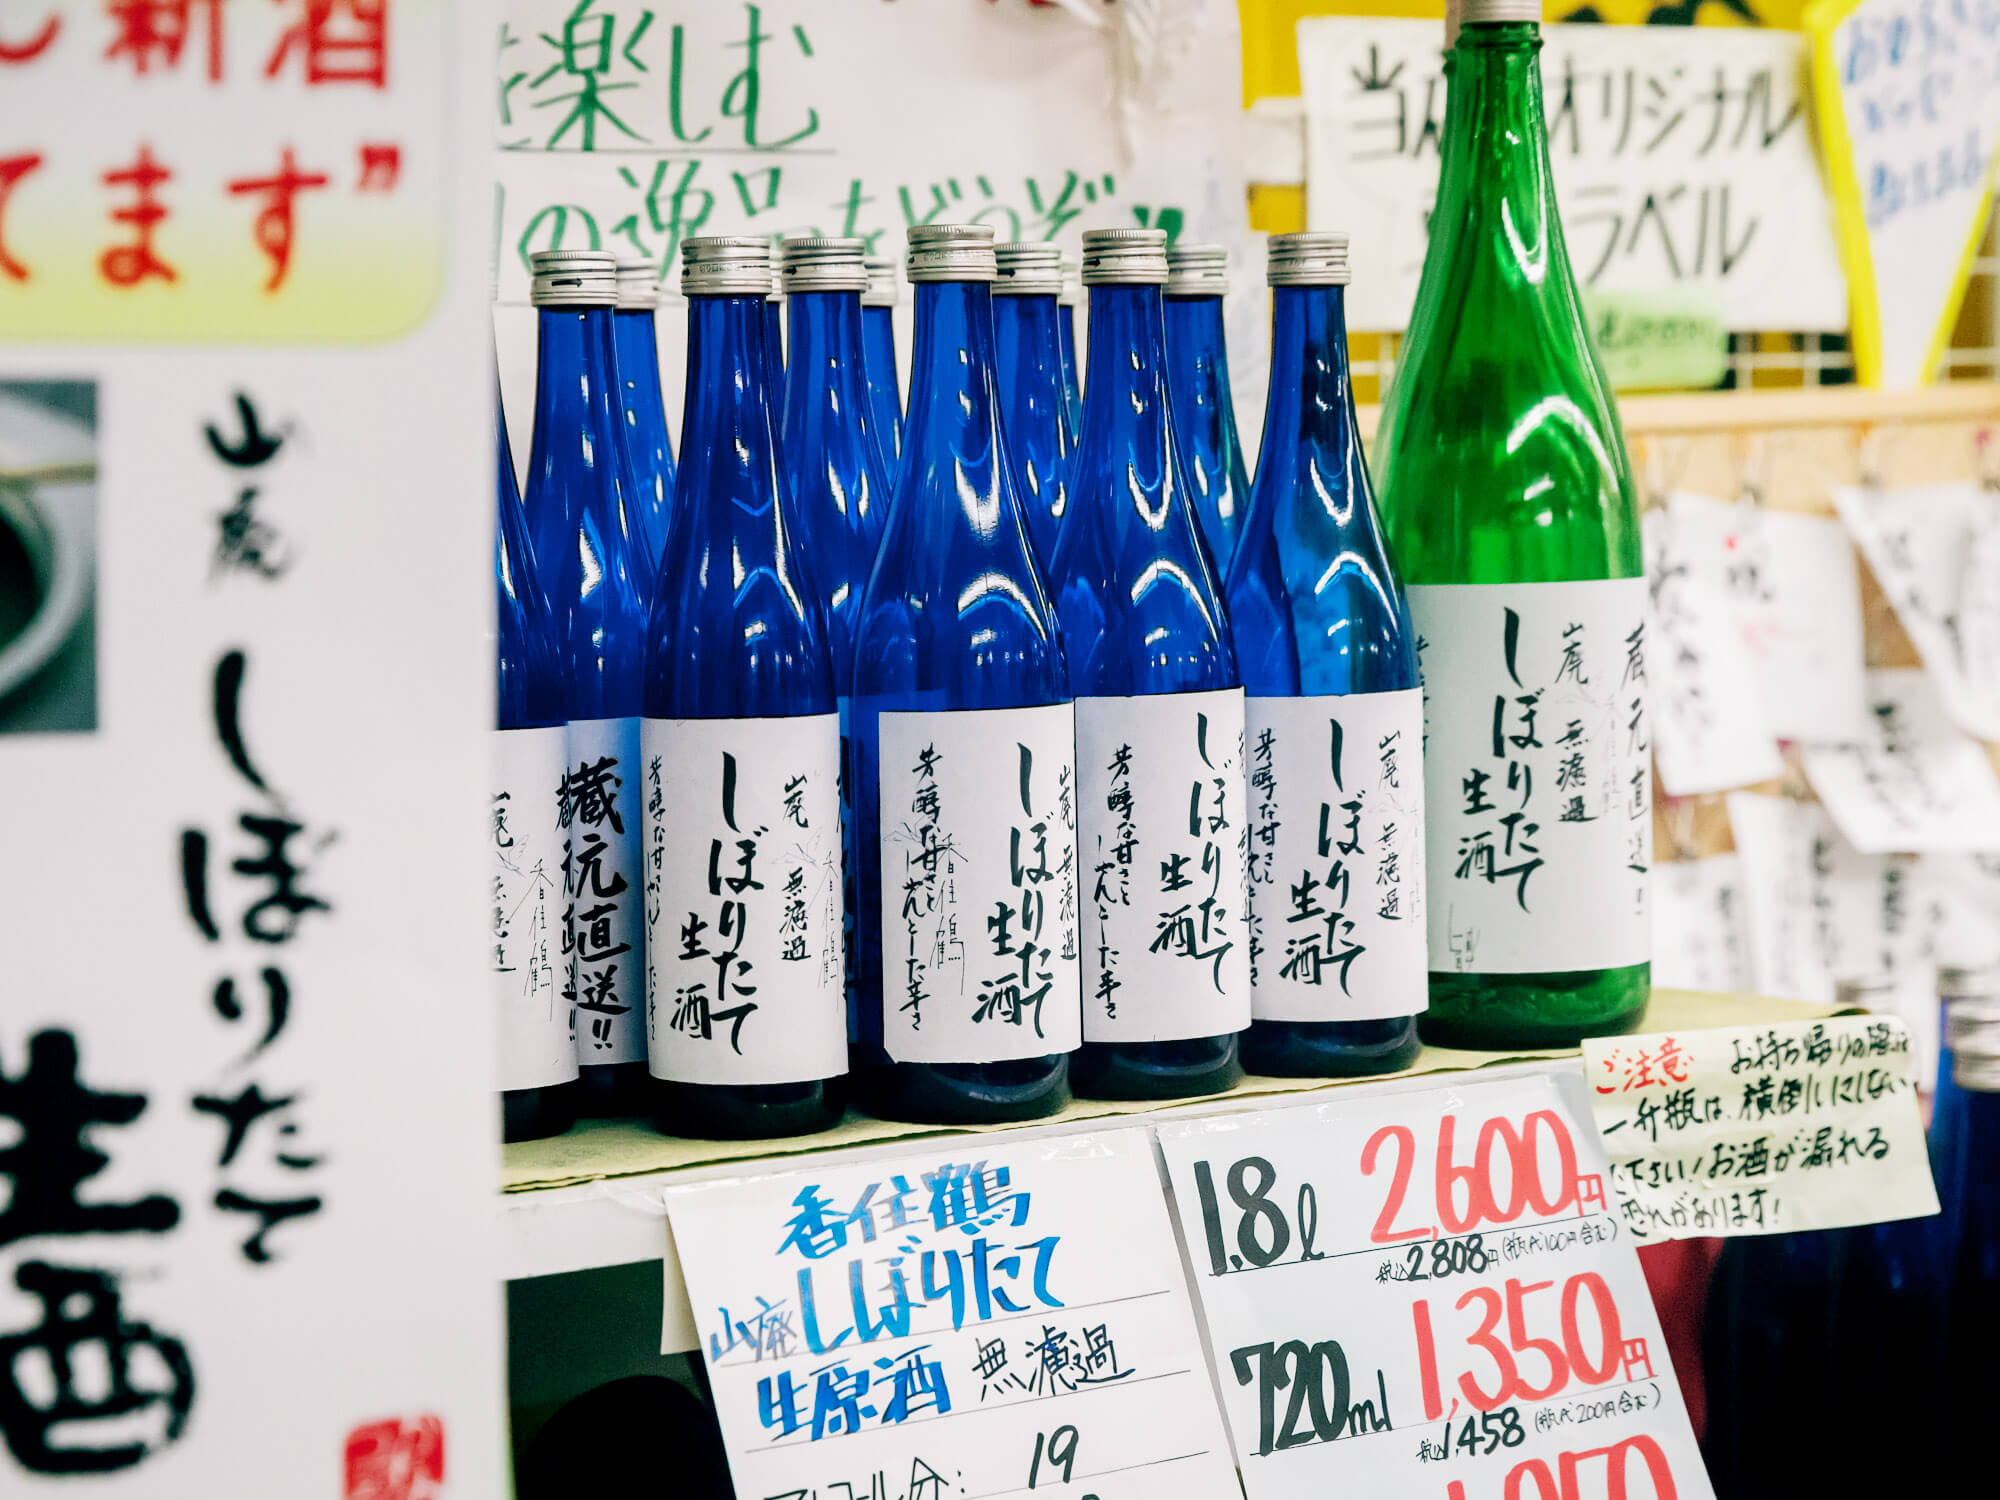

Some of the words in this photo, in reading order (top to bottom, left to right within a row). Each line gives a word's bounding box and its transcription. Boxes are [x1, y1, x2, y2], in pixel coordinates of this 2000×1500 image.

[1492, 606, 1545, 914] しぼりたて
[1189, 711, 1234, 995] しぼりたて
[1317, 718, 1366, 997] しぼりたて
[1454, 768, 1497, 884] 生酒
[707, 751, 769, 1056] しぼりたて
[1009, 742, 1056, 1039] しぼりたて
[1148, 853, 1197, 958] 生酒
[1279, 870, 1323, 986] 生酒
[178, 646, 338, 1265] しぼりたて
[669, 911, 713, 1040] 生酒
[971, 902, 1022, 1026] 生酒
[1595, 1036, 1695, 1095] ご注意
[775, 1159, 1031, 1260] 香住鶴
[1359, 1109, 1608, 1244] 2,600円
[796, 1234, 1066, 1357] しぼりたて
[755, 1344, 952, 1442] 生原酒
[971, 1322, 1136, 1402] 無濾過
[1229, 1338, 1393, 1457] 720ml
[1411, 1271, 1654, 1423] 1,350円
[1027, 1424, 1080, 1490] 19
